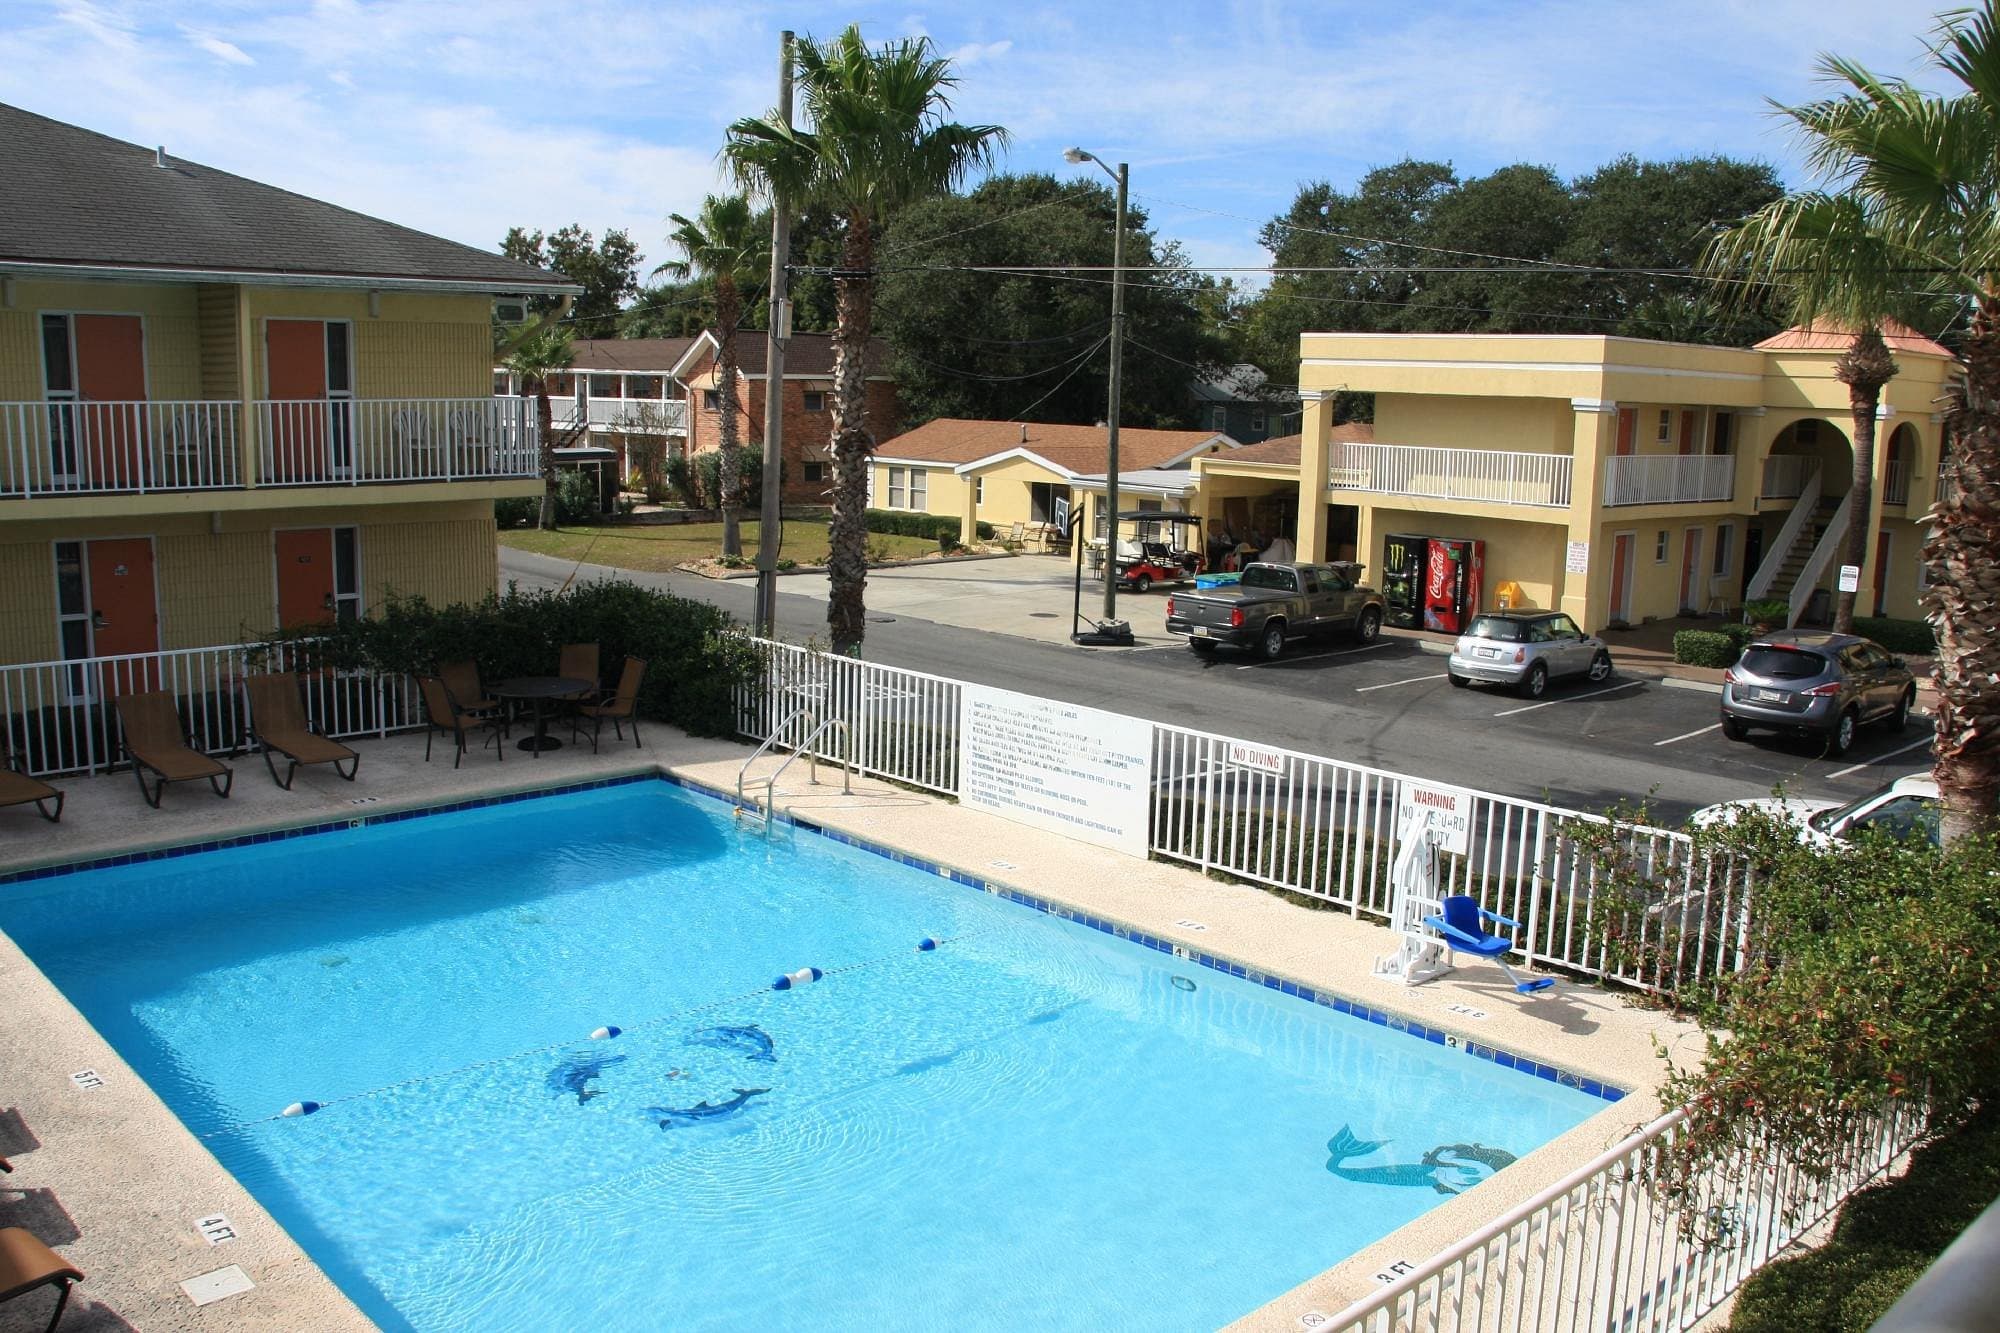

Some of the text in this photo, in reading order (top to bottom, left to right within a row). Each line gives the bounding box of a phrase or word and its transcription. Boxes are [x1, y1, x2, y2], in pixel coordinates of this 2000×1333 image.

[1429, 547, 1444, 599] Coca-Cola
[1234, 747, 1280, 769] NO DIVING
[1414, 789, 1456, 811] WARNING
[1402, 805, 1414, 819] NO
[1433, 831, 1450, 846] UTY
[1447, 1037, 1457, 1048] 3
[74, 1071, 104, 1089] 5 FT
[201, 1218, 237, 1244] 4 FT
[1376, 1260, 1415, 1284] 3 FT
